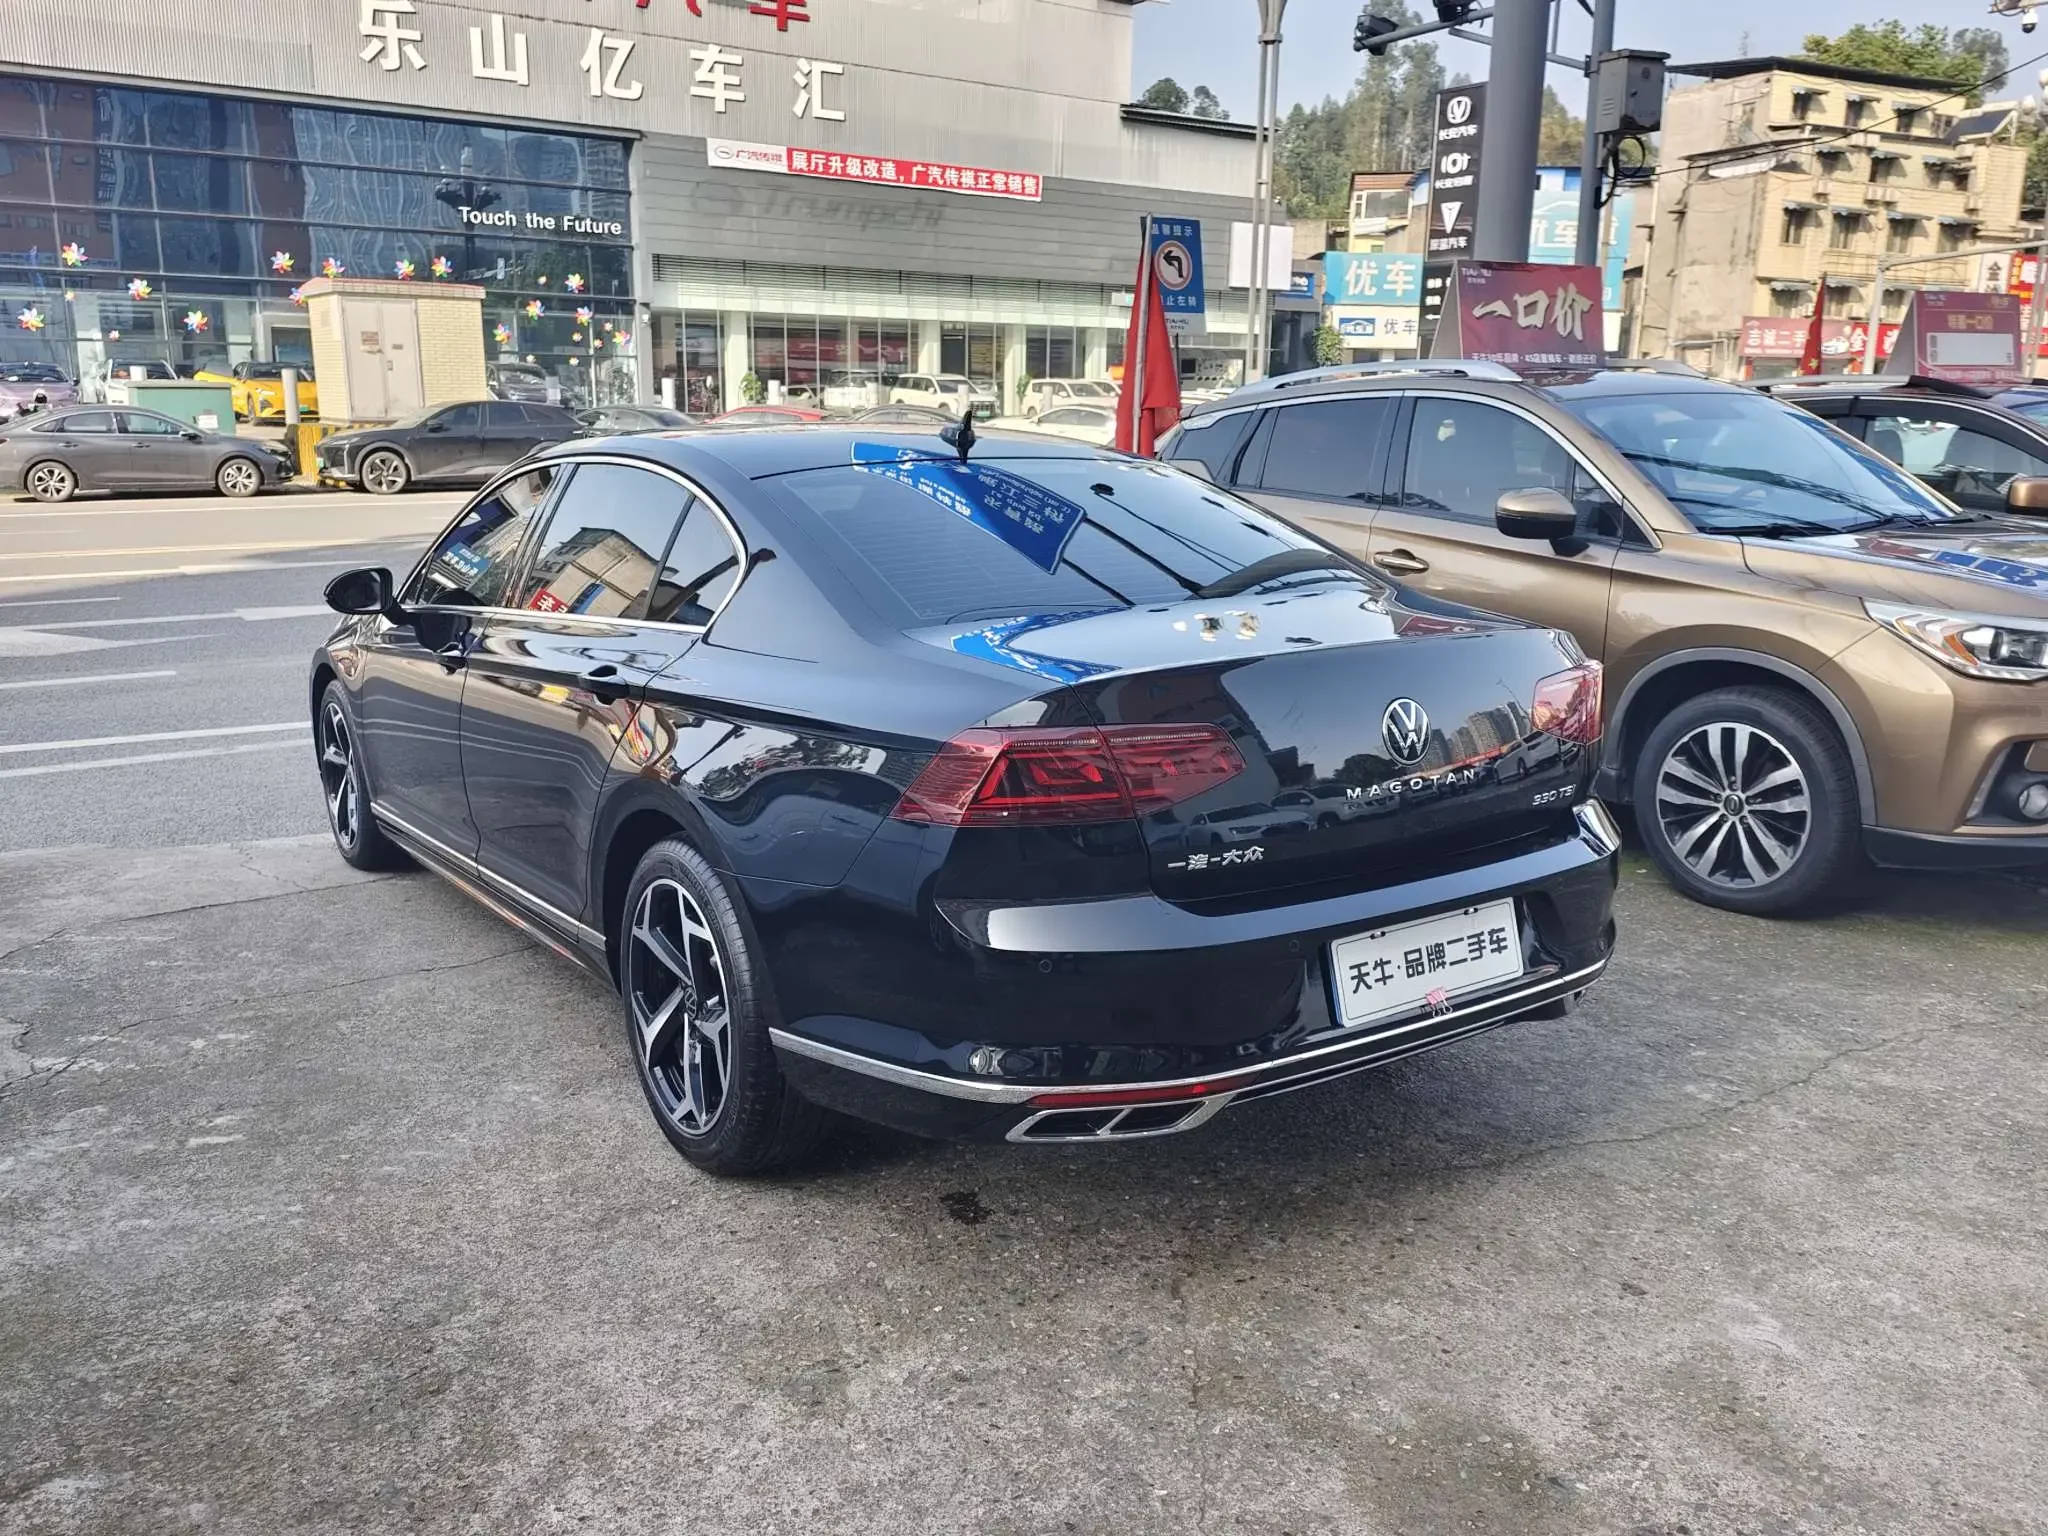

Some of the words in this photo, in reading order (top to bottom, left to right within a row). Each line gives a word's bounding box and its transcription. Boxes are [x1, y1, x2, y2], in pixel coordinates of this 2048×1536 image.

[359, 0, 847, 122] 乐山亿车汇
[457, 206, 517, 227] Touch
[525, 212, 556, 230] the
[563, 215, 622, 235] Future
[1344, 259, 1417, 297] 优车
[1160, 295, 1197, 308] 止左转
[1472, 281, 1594, 341] 一口价
[1345, 768, 1475, 801] MAGOTAN
[1349, 926, 1509, 995] 天牛·品牌二手车
